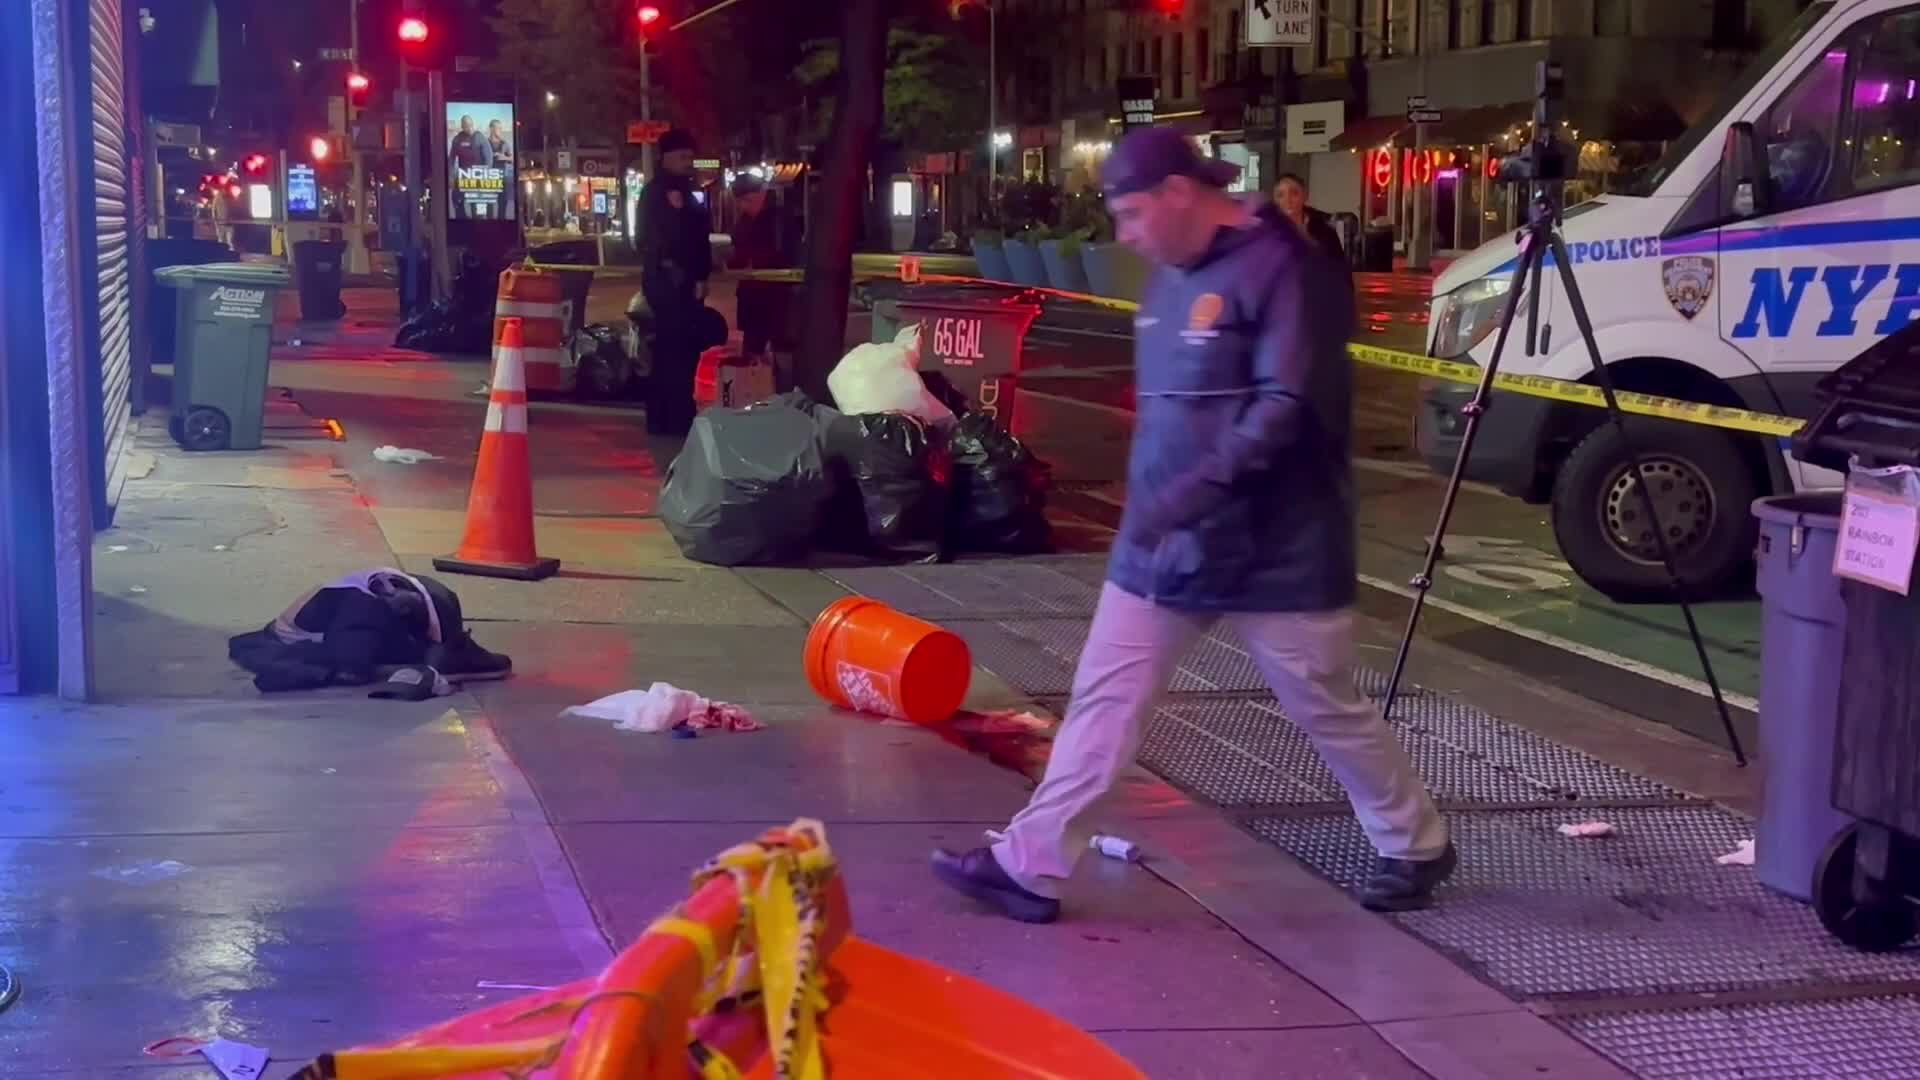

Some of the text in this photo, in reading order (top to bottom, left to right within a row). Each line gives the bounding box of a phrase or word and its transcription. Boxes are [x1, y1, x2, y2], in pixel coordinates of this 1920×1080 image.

[1276, 0, 1309, 14] TURN
[1276, 20, 1307, 35] LANE
[458, 168, 504, 180] NCIS:
[1575, 236, 1659, 264] POLICE
[934, 318, 985, 359] 65 GAL
